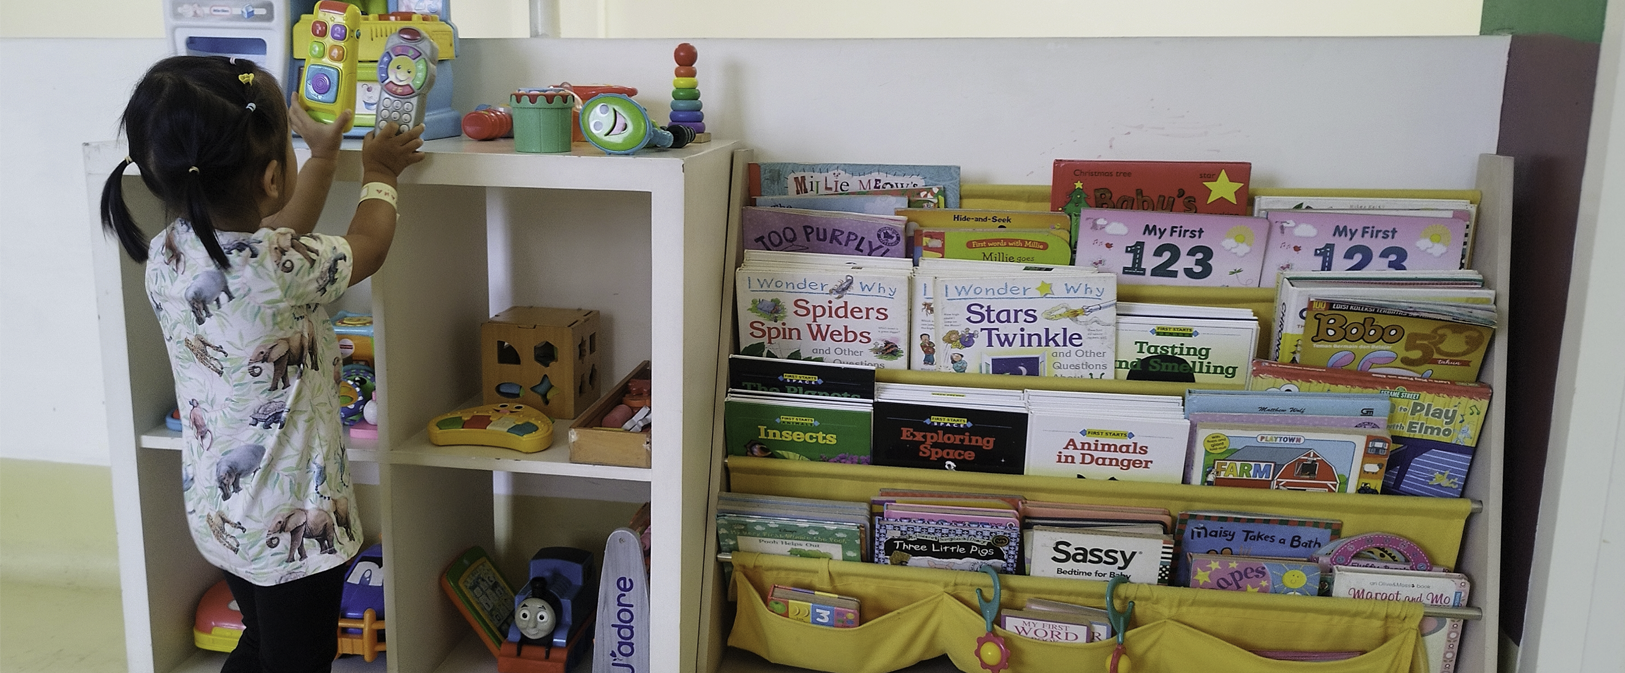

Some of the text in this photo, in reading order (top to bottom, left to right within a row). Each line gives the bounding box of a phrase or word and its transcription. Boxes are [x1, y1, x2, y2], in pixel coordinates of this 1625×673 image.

[334, 26, 341, 38] 2
[331, 48, 339, 59] 4
[1073, 168, 1114, 177] Christmas
[1094, 187, 1198, 214] Baby's
[953, 214, 1012, 223] Hide-and-Seek
[754, 226, 798, 251] TOO
[1142, 224, 1205, 239] My First
[1332, 225, 1398, 241] My First
[971, 240, 986, 248] First
[1024, 241, 1044, 249] Millie
[982, 252, 1015, 263] Millie
[1122, 241, 1214, 280] 123
[1312, 243, 1408, 271] 123
[747, 277, 897, 297] I Wonder Why
[944, 282, 1105, 297] I Wonder Why
[793, 298, 889, 323] Spiders
[965, 303, 1038, 324] Stars
[749, 321, 872, 345] Spin Webs
[1311, 313, 1405, 344] Bobo
[980, 327, 1083, 348] Twinkle
[811, 347, 864, 357] and Other
[1075, 349, 1107, 357] Other
[1134, 341, 1212, 360] Tasting
[1052, 362, 1108, 370] Questions
[1115, 358, 1239, 378] nd Smelling
[1401, 392, 1420, 400] STREET
[1410, 401, 1457, 425] Play
[757, 425, 837, 445] Insects
[1406, 421, 1452, 437] Elmo
[900, 427, 996, 450] Exploring
[1063, 438, 1148, 455] Animals
[1260, 436, 1301, 444] PLAYTOWN
[918, 444, 976, 460] Space
[1056, 451, 1153, 471] in Danger
[1216, 462, 1272, 479] FARM
[1190, 525, 1236, 542] Maisy
[1241, 529, 1276, 543] Takes
[1289, 535, 1322, 549] Bath
[893, 540, 995, 557] Three Little Pigs
[1051, 540, 1137, 570] Sassy
[1056, 568, 1092, 577] Bedtime
[815, 608, 830, 623] 3
[1013, 625, 1079, 642] WORD
[1022, 620, 1070, 631] MY FIRST
